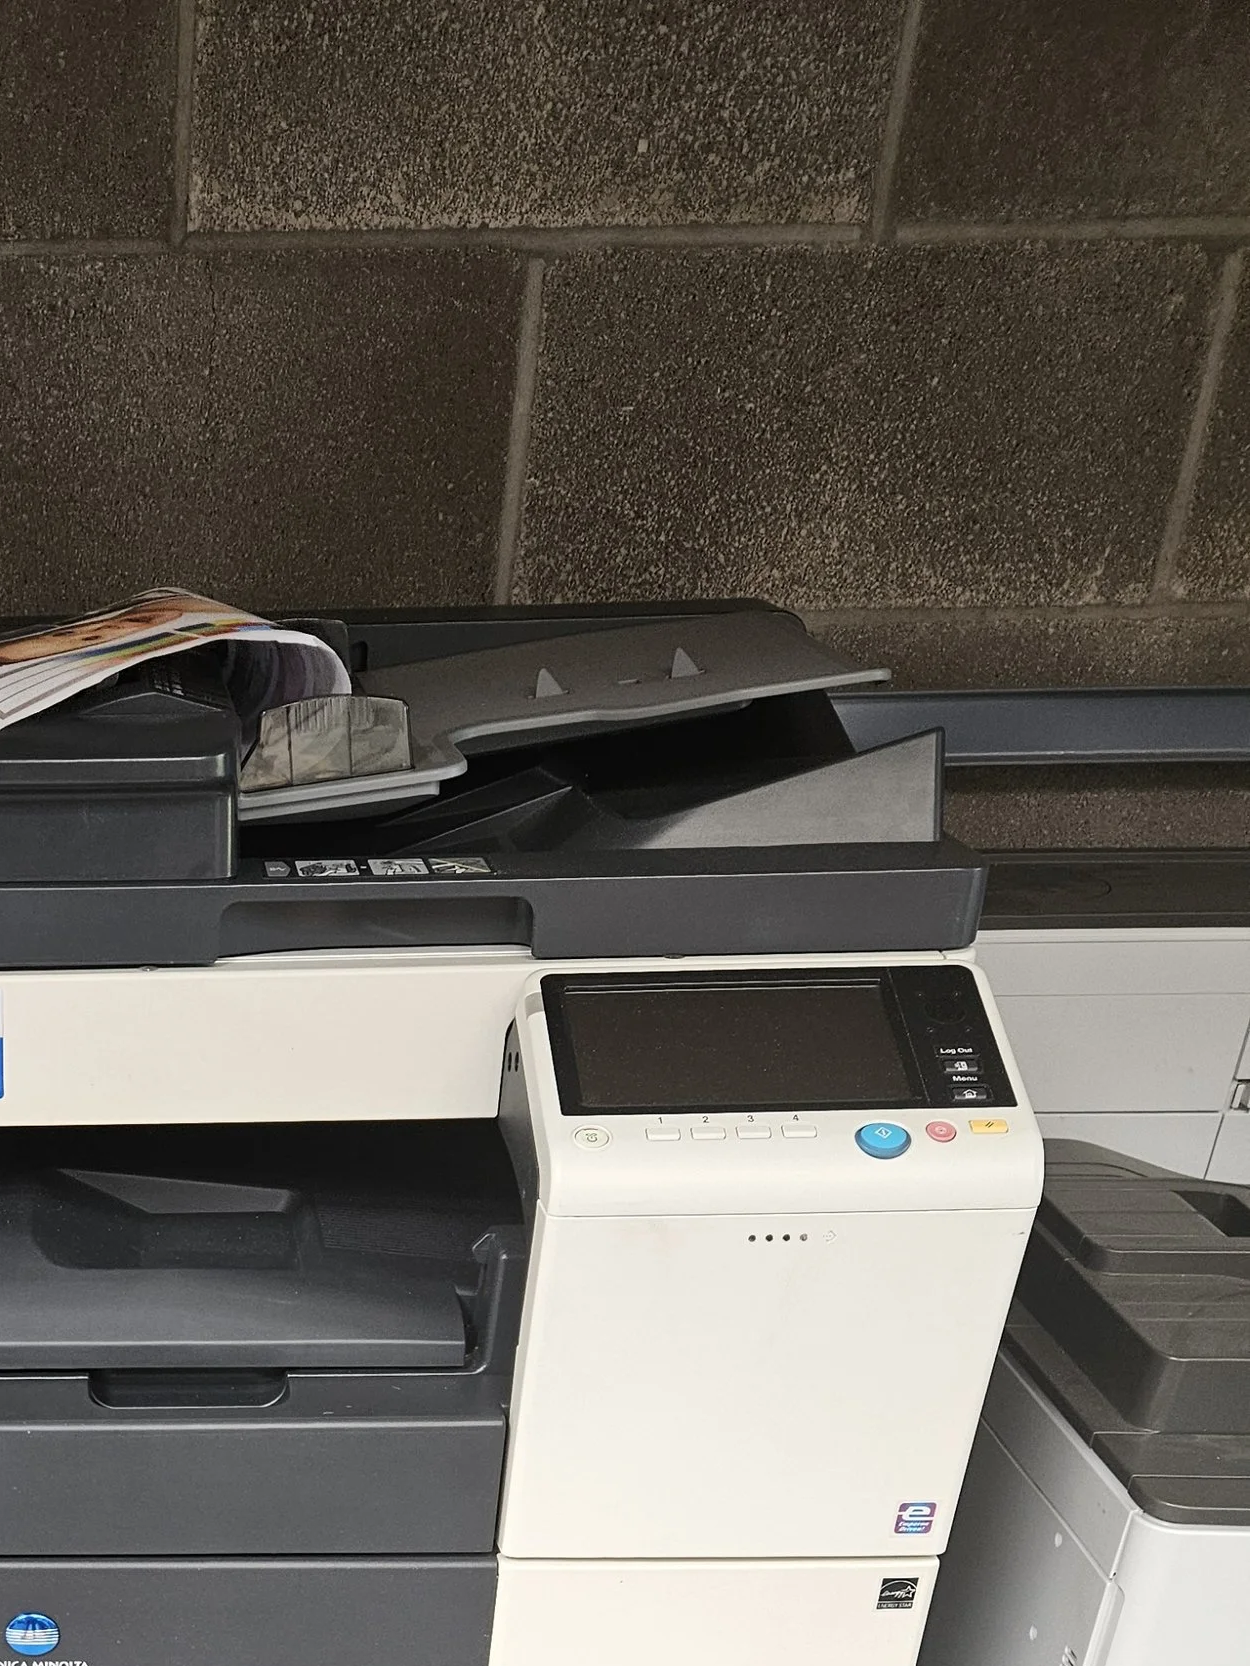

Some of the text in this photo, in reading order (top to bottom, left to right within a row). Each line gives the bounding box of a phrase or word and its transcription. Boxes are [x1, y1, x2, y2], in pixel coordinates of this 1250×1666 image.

[658, 1116, 663, 1124] 1
[702, 1115, 710, 1123] 2
[747, 1114, 754, 1123] 3
[792, 1114, 800, 1122] 4
